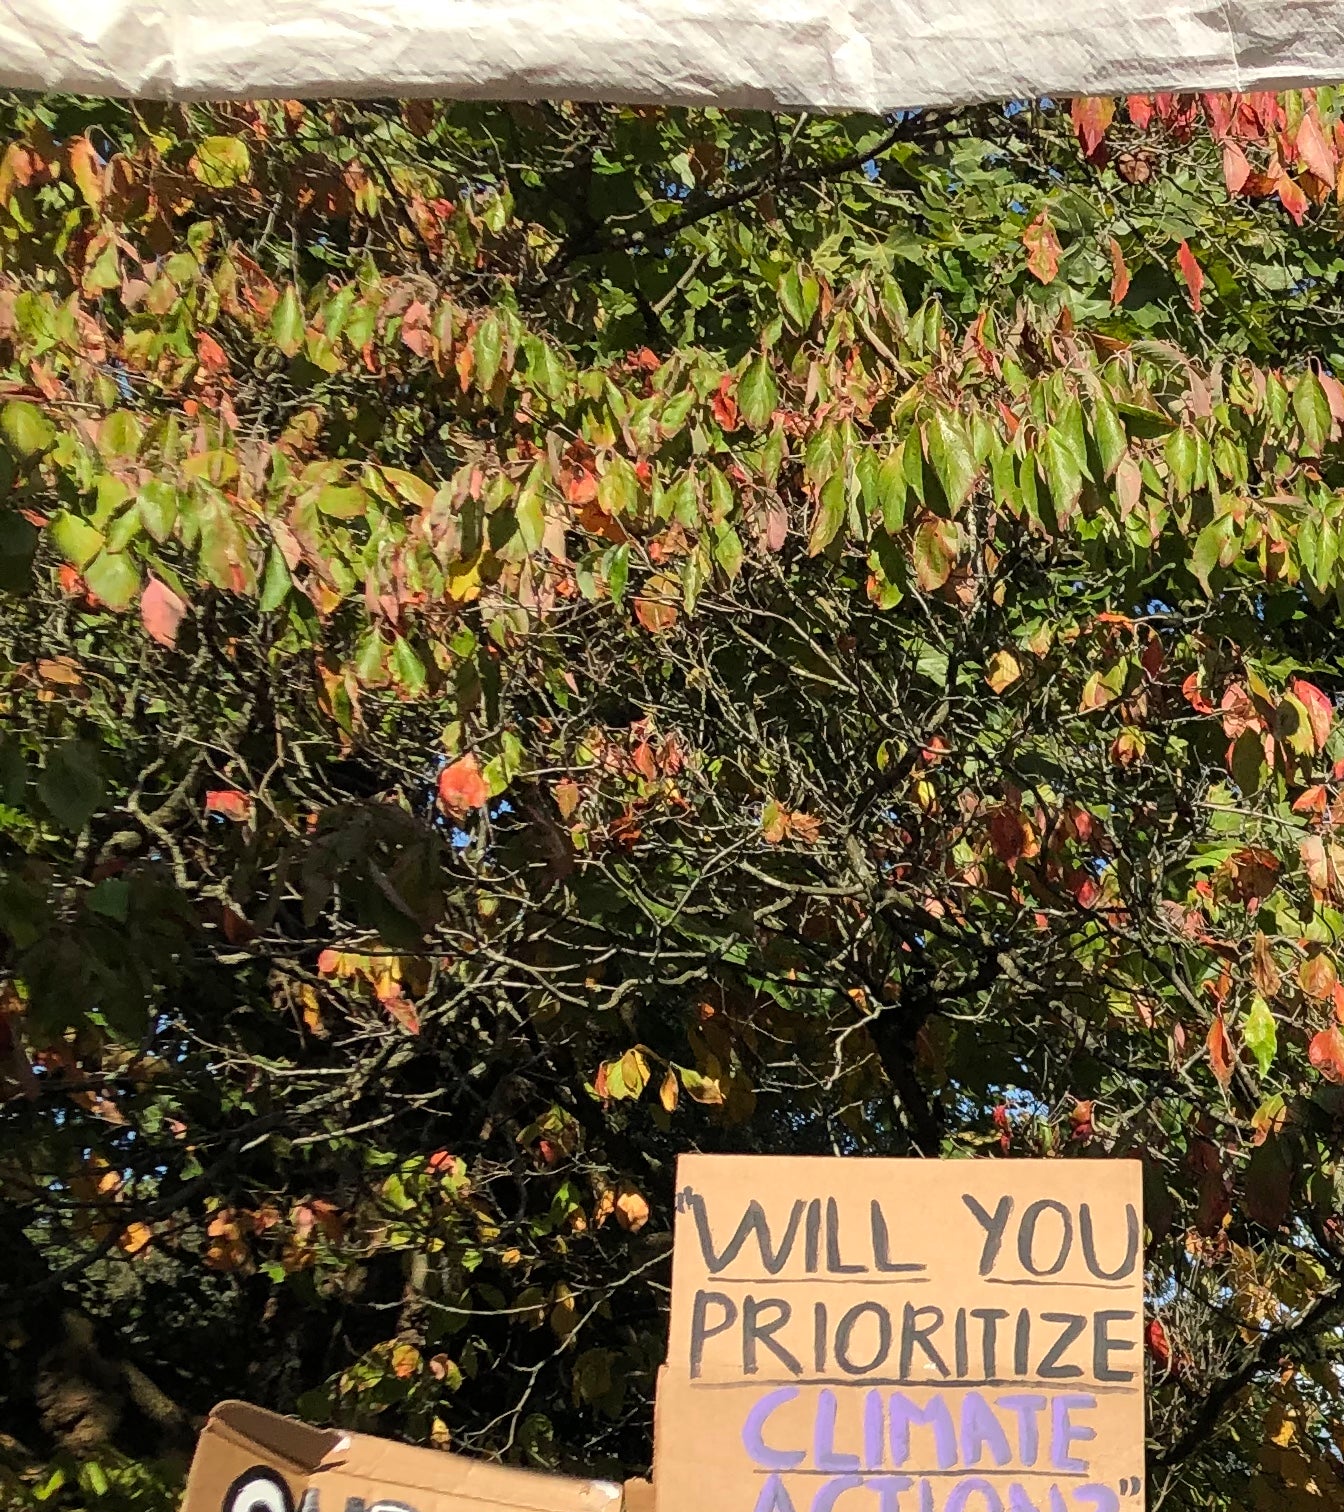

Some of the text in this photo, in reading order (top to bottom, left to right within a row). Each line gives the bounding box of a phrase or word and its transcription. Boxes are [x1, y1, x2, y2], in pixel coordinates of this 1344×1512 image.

[962, 1193, 1139, 1280] YOU
[690, 1289, 1139, 1381] PRIORITIZE
[741, 1386, 1098, 1471] CLIMATE
